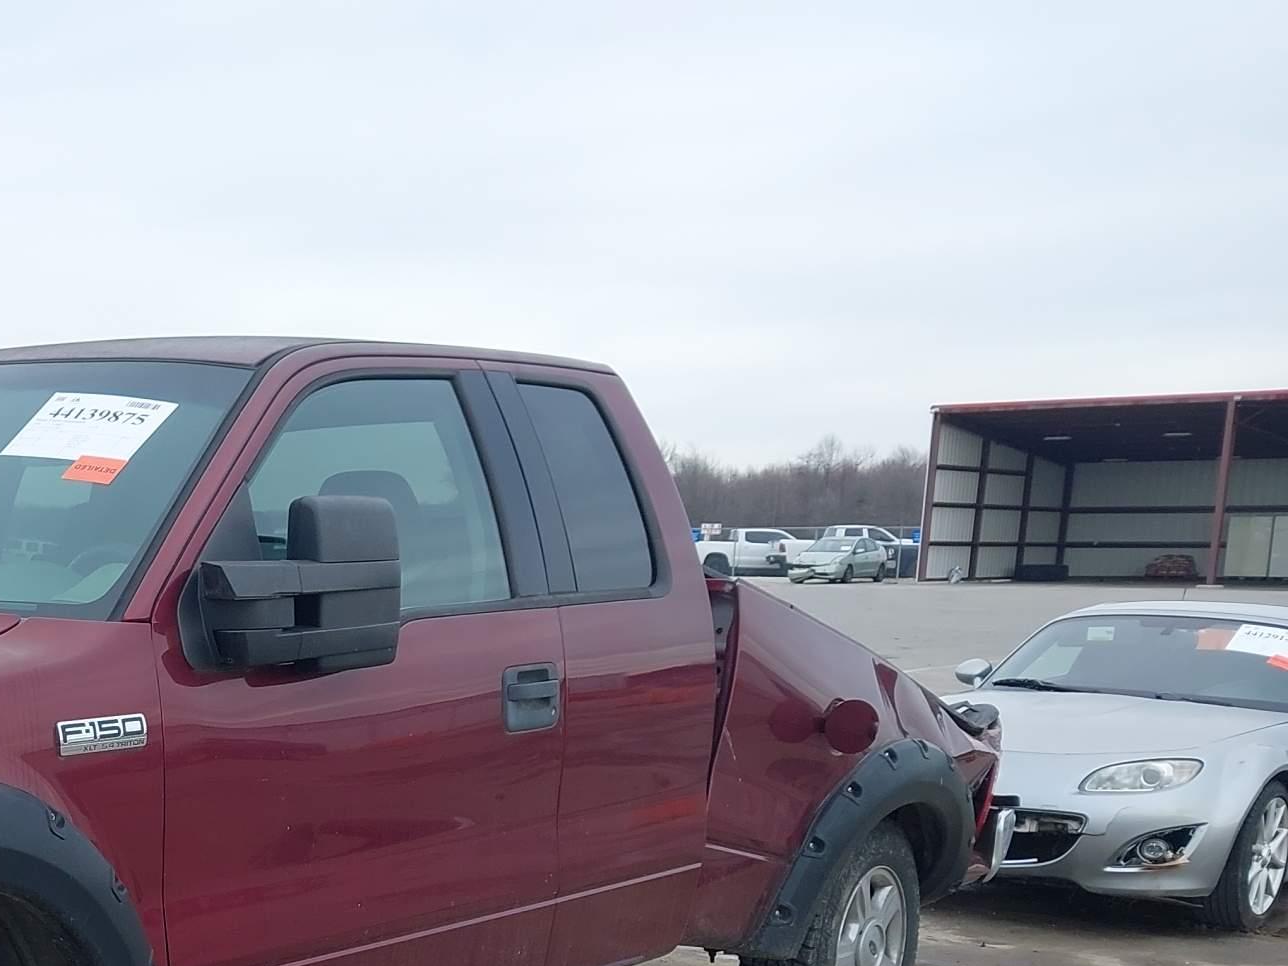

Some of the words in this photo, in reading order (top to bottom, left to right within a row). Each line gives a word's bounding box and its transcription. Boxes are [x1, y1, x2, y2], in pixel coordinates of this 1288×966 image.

[49, 406, 150, 425] 44139875
[73, 463, 117, 475] DETAILED
[60, 716, 145, 743] F-150
